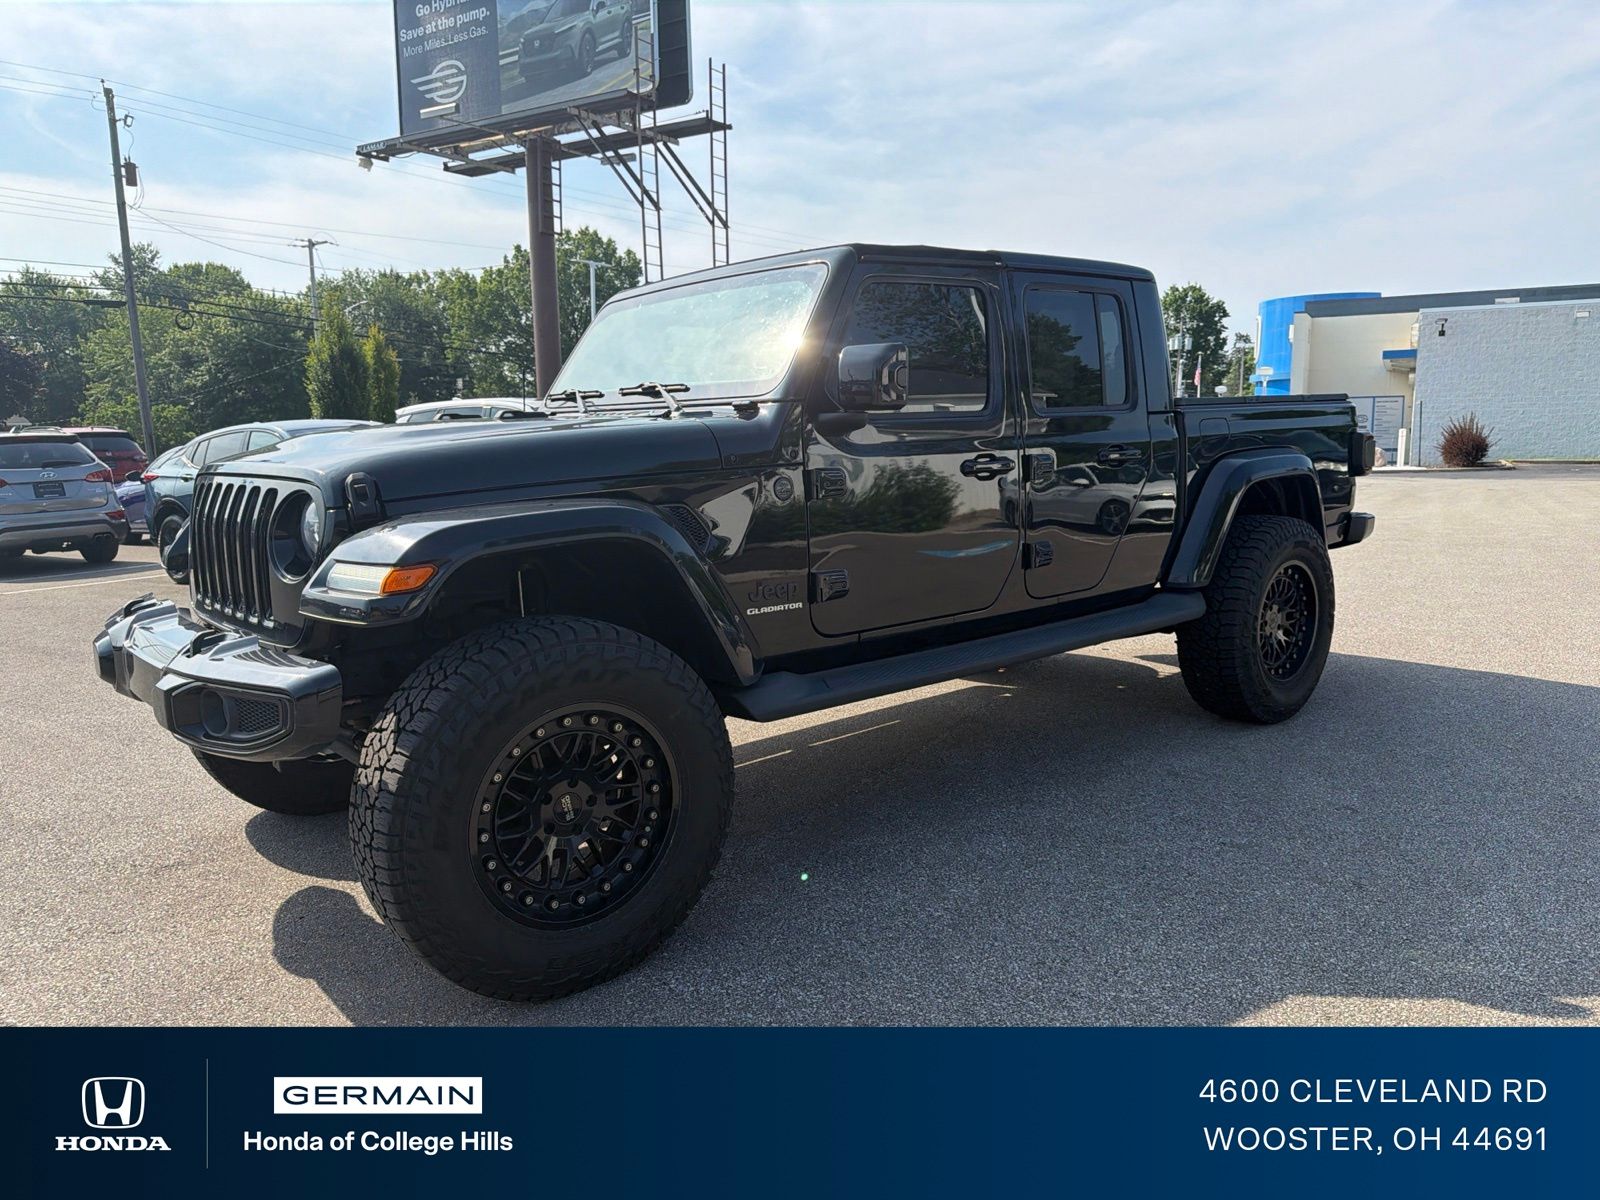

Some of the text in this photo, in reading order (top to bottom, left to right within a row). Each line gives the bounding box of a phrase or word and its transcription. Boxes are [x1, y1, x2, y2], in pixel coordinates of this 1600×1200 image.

[415, 4, 430, 17] Go
[400, 6, 490, 42] Save at the pump.
[403, 45, 423, 57] More
[448, 31, 469, 44] Less
[469, 26, 489, 38] Gas.
[747, 580, 797, 602] Jeep
[746, 601, 803, 615] GLADIATOR
